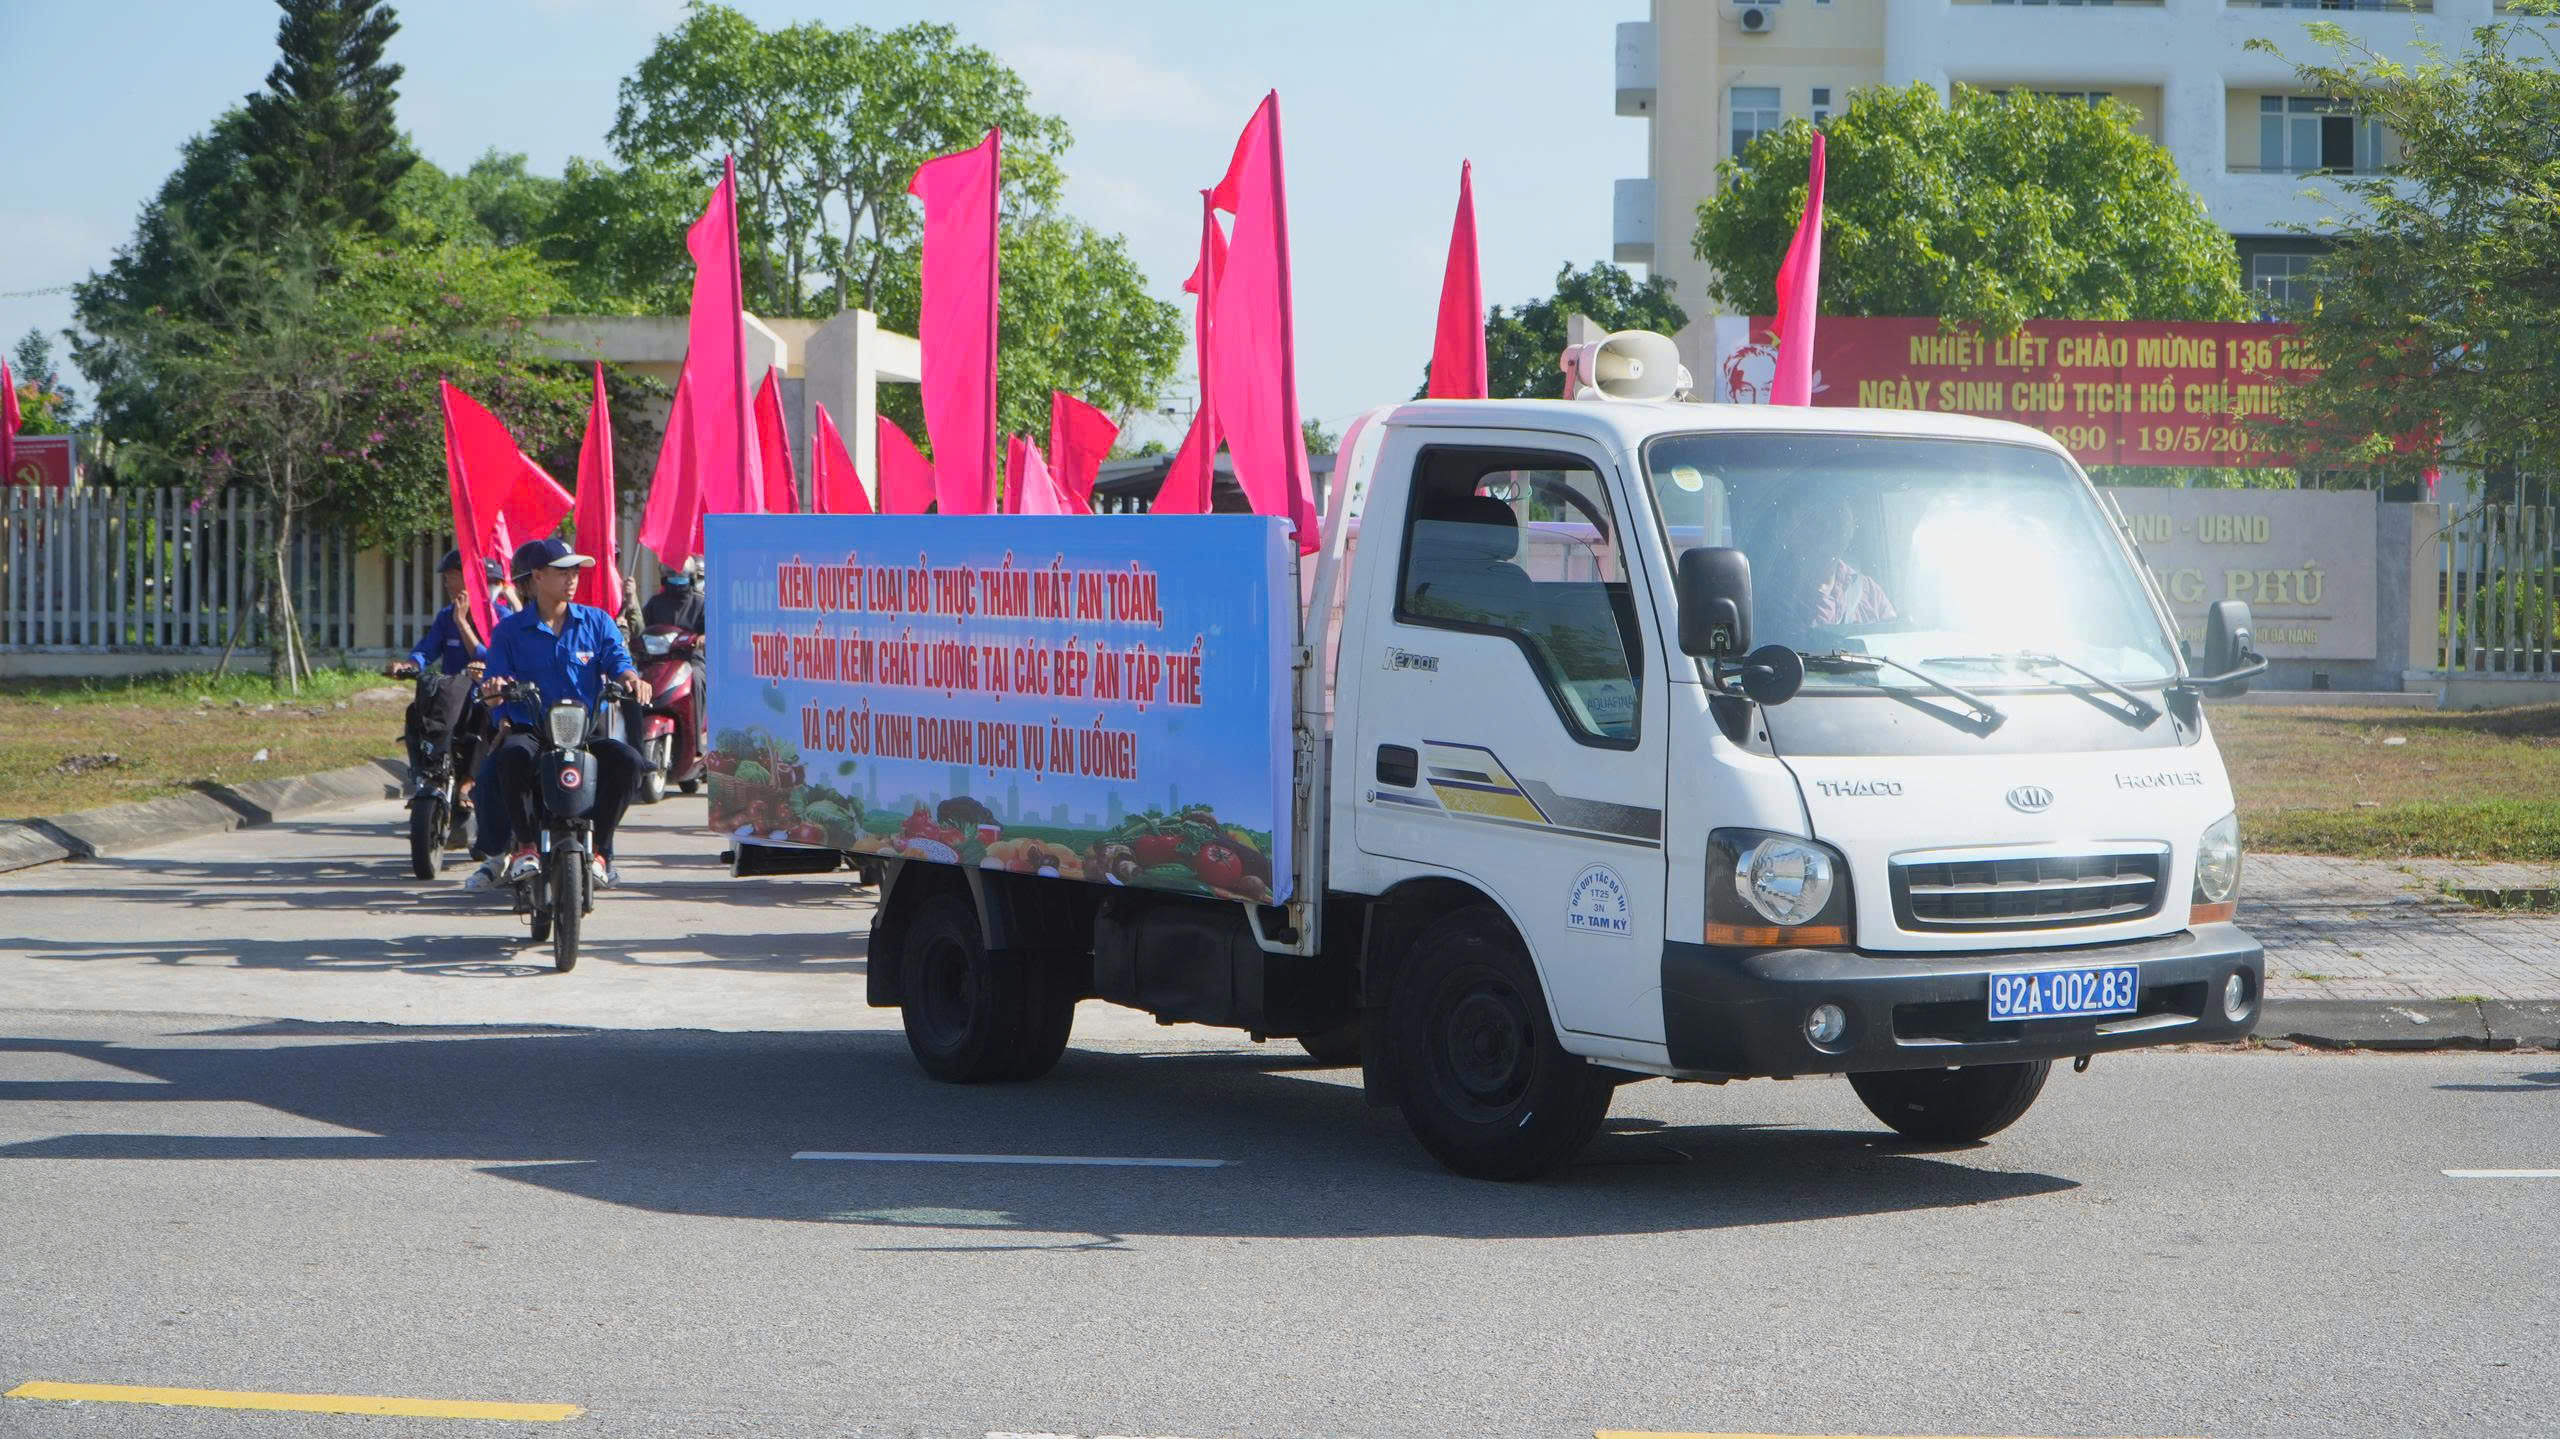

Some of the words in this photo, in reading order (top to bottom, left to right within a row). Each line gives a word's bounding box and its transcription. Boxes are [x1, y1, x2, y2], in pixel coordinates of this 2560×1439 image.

[1910, 331, 1985, 372] NHIỆT
[1996, 332, 2049, 373] LIỆT
[2057, 332, 2128, 368] CHÀO
[2137, 332, 2216, 369] MỪNG
[2226, 340, 2272, 369] 136
[1859, 375, 1930, 410] NGÀY
[1939, 381, 2003, 411] SINH
[2012, 373, 2065, 412] CHỦ
[2073, 383, 2132, 418] TỊCH
[2140, 373, 2175, 413] HỒ
[2184, 377, 2228, 413] CHÍ
[2237, 384, 2291, 415] MIN
[2034, 424, 2106, 452] 890
[2199, 515, 2270, 543] UBND
[778, 557, 813, 609] KIÊN
[817, 553, 864, 614] QUYẾT
[868, 568, 902, 622] LOẠI
[908, 554, 929, 613] BỎ
[933, 565, 976, 624] THỰC
[980, 552, 1029, 617] THẨM
[1034, 555, 1071, 618] MẤT
[1077, 573, 1103, 620] AN
[1107, 563, 1162, 628] TOÀN,
[2224, 560, 2325, 604] PHÚ
[752, 632, 789, 687] THỰC
[793, 620, 836, 681] PHẨM
[841, 630, 874, 683] KÉM
[879, 626, 919, 686] CHẤT
[924, 639, 978, 698] LƯỢNG
[983, 646, 1008, 702] TẠI
[1015, 638, 1048, 694] CÁC
[1054, 635, 1088, 697] BẾP
[1094, 642, 1119, 699] ĂN
[1125, 644, 1160, 712] TẬP
[1166, 635, 1202, 705] THỂ
[802, 699, 821, 751] VÀ
[826, 705, 846, 753] CƠ
[850, 698, 870, 755] SỞ
[875, 713, 912, 759] KINH
[917, 717, 973, 765] DOANH
[978, 721, 1017, 777] DỊCH
[1022, 725, 1044, 782] VỤ
[1050, 717, 1074, 774] ĂN
[1080, 714, 1137, 780] UỐNG!
[1816, 780, 1904, 797] THACO
[2114, 772, 2204, 789] FRONTIER
[2013, 787, 2051, 808] KIA
[1580, 874, 1593, 890] QUY
[1570, 913, 1585, 926] TP.
[1588, 915, 1610, 928] TAM
[1593, 903, 1605, 913] 3N
[1995, 970, 2133, 1015] 92A-002.83
